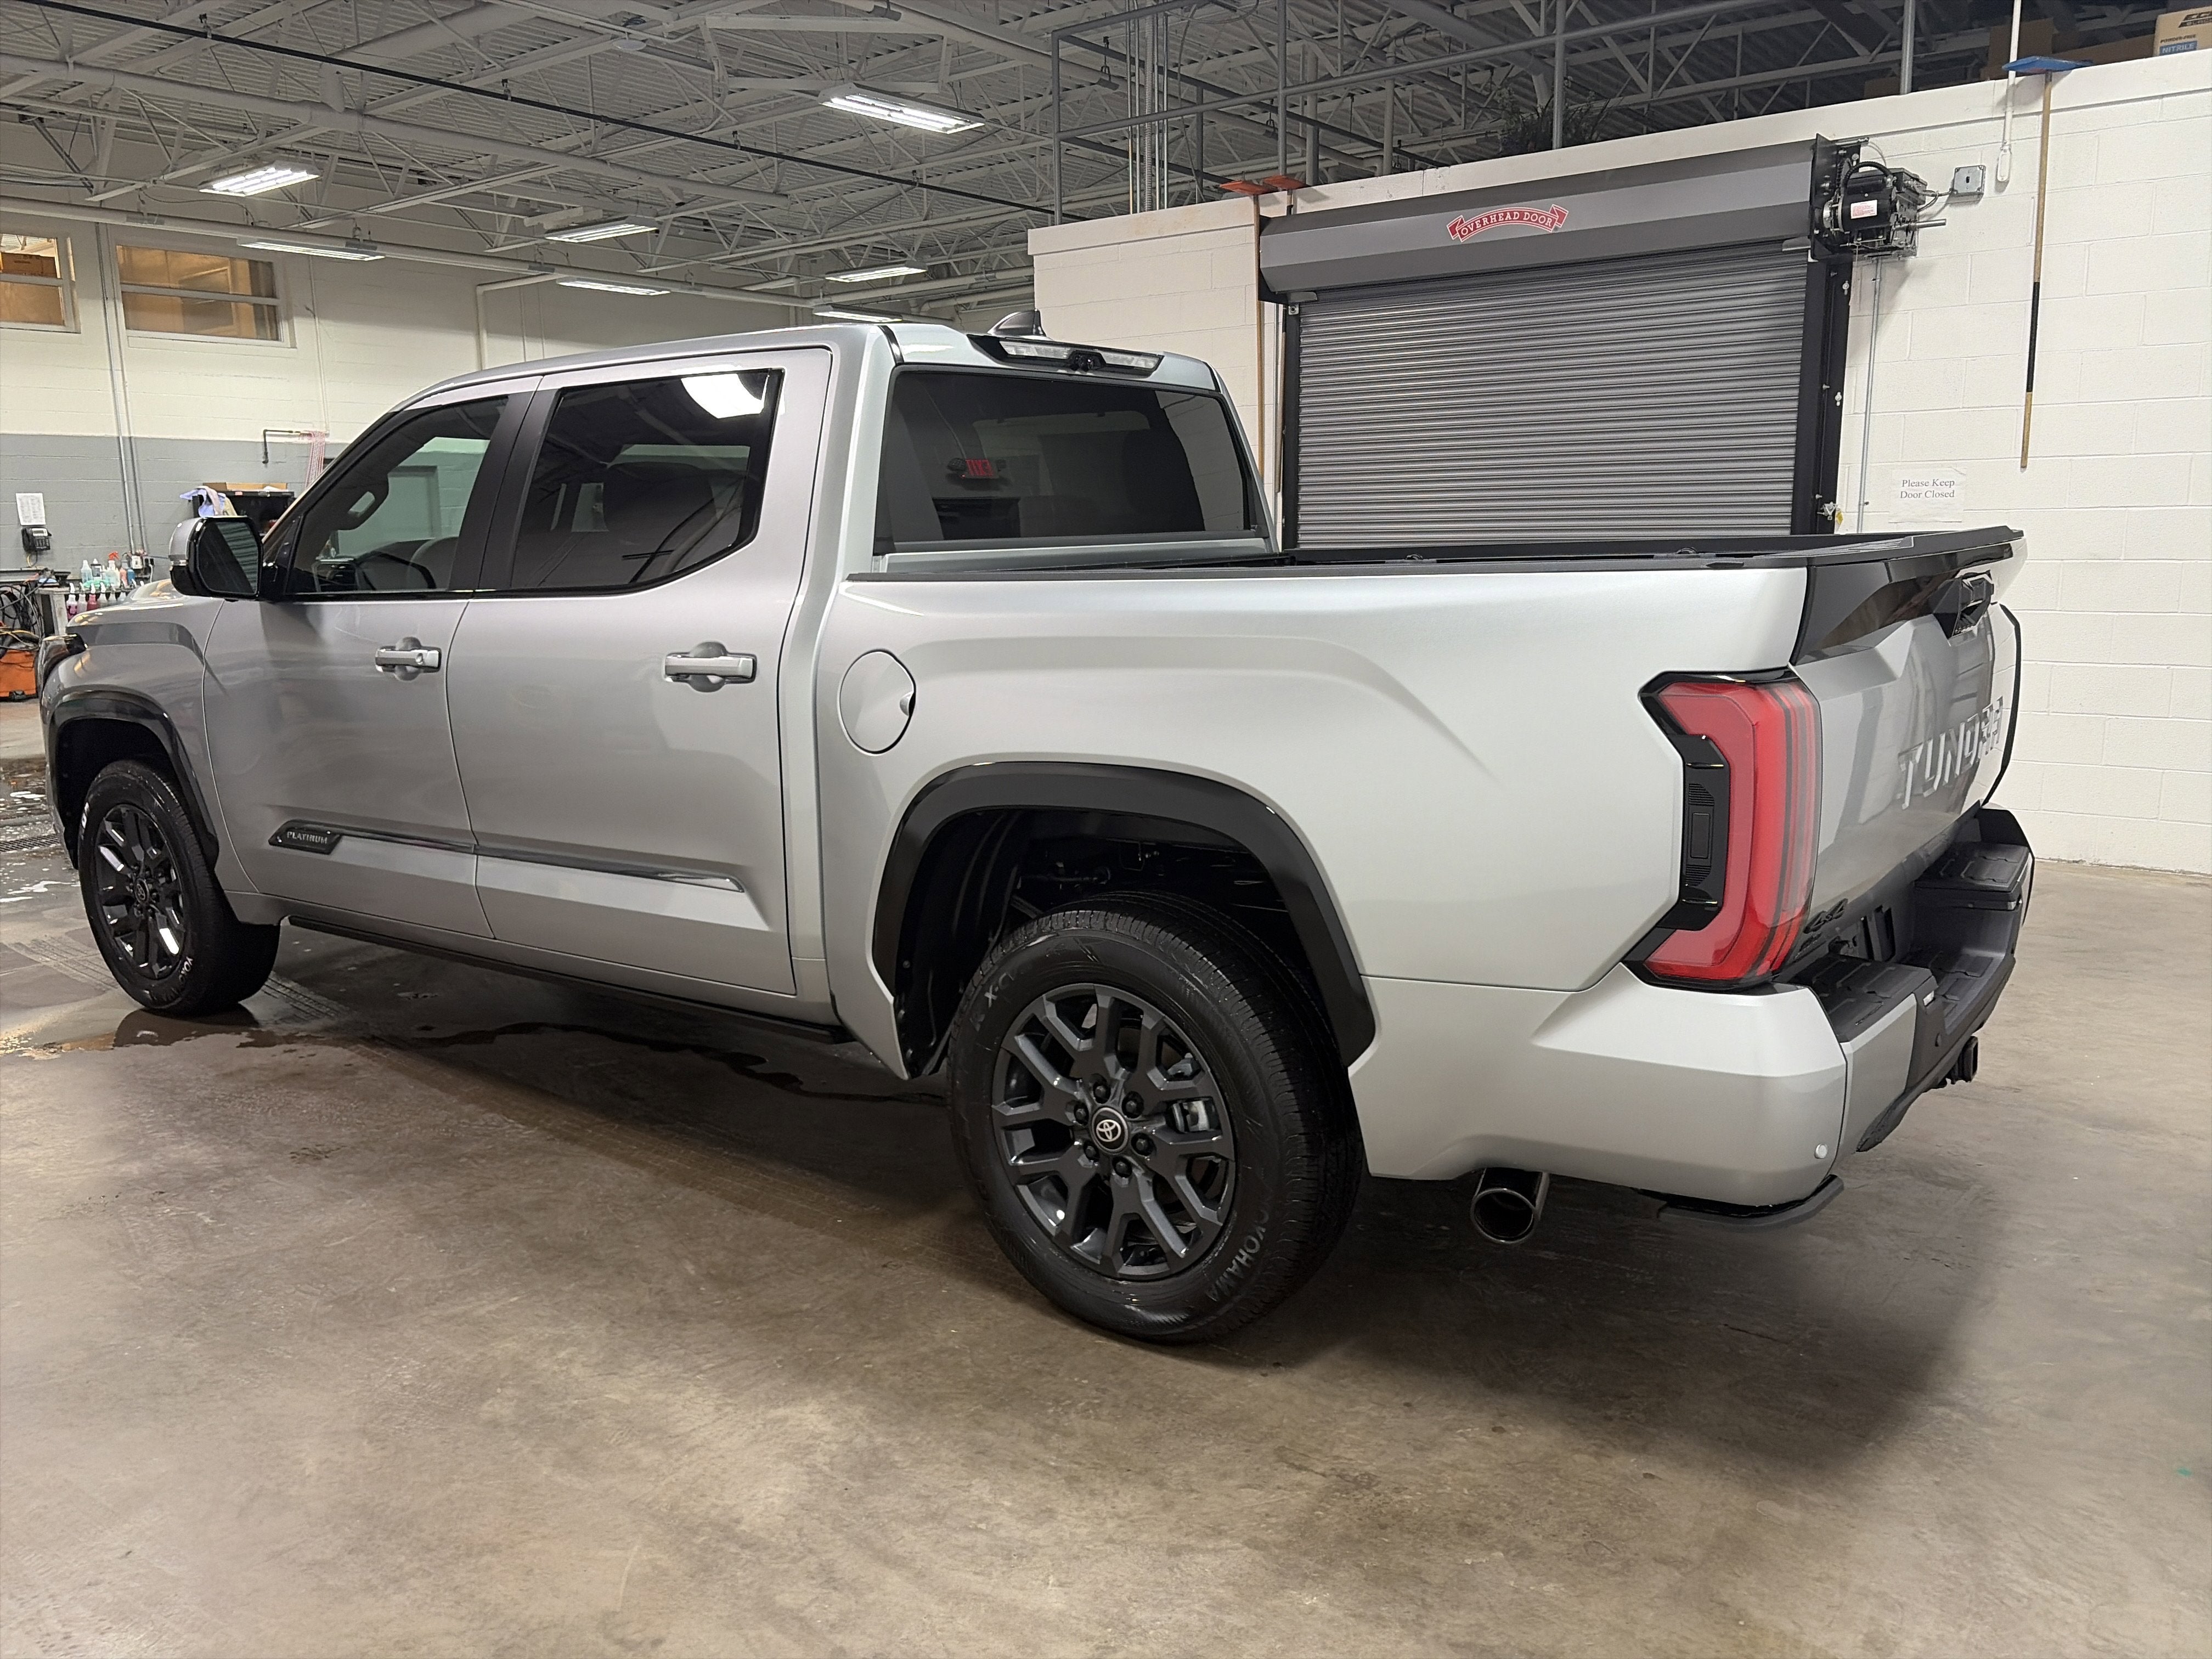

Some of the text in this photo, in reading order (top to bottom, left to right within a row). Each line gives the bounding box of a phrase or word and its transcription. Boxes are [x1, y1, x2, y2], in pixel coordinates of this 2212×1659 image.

[2162, 43, 2194, 54] NITRILE
[1460, 211, 1552, 236] OVERHEAD DOOR
[1901, 478, 1955, 488] Please Keep
[1900, 490, 1955, 499] Door Closed
[287, 831, 328, 844] PLATINUM
